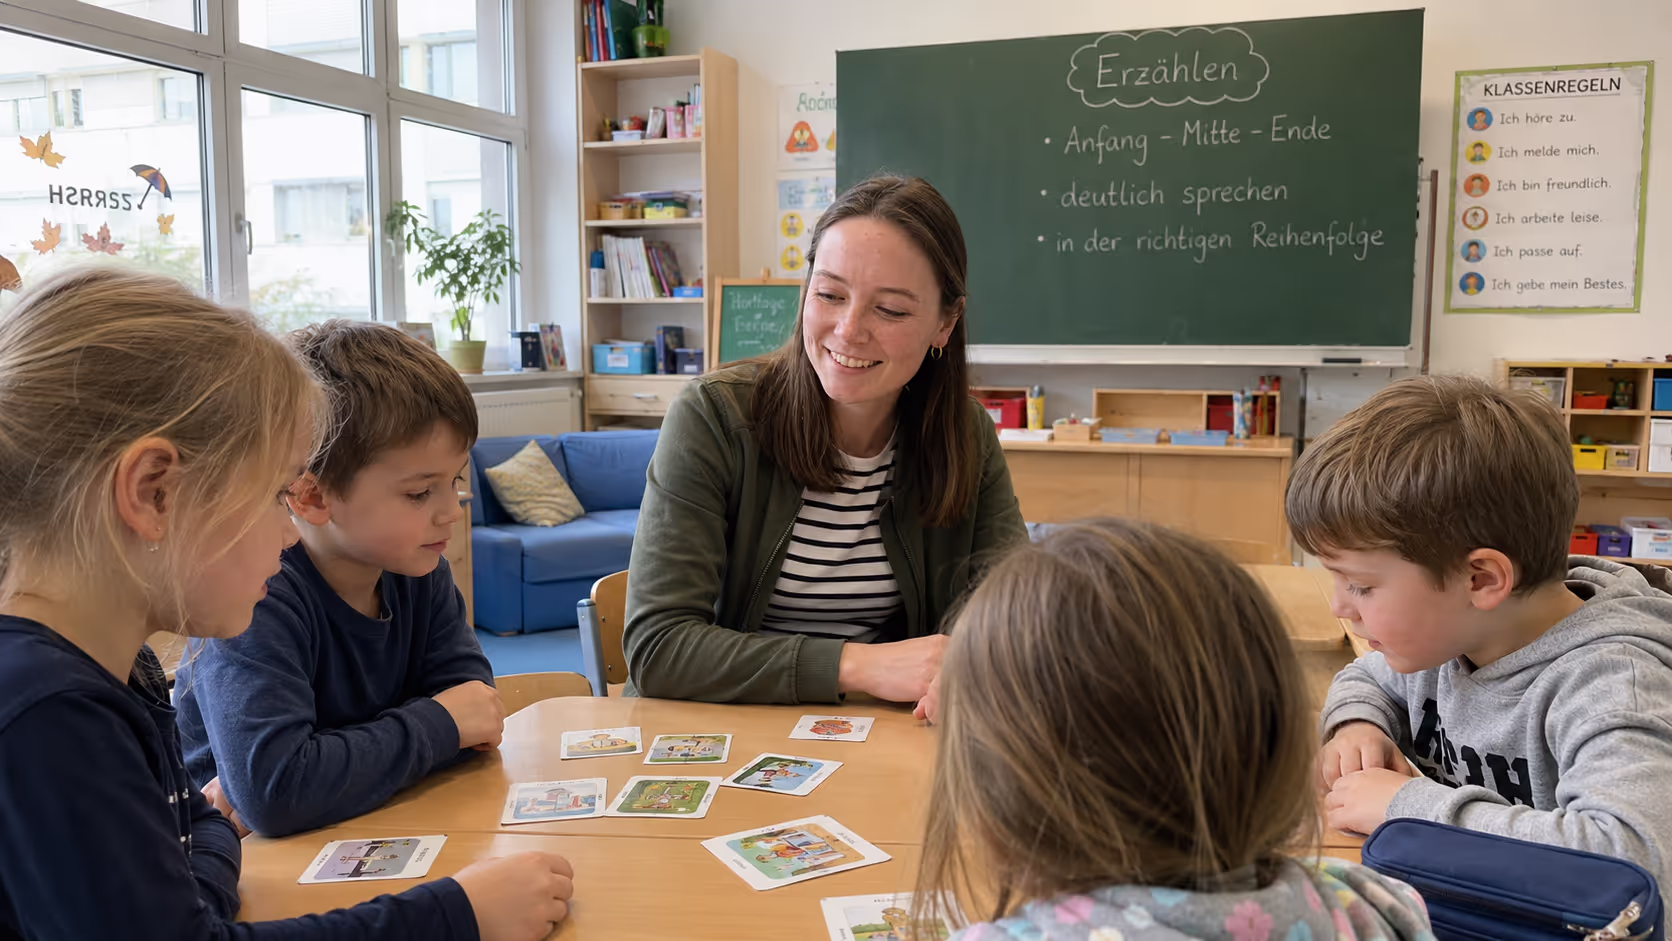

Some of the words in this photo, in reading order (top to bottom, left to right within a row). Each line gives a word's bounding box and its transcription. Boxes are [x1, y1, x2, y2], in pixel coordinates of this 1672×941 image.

[1097, 51, 1237, 88] Erzählen
[1484, 77, 1620, 96] KLASSENREGELN
[1500, 113, 1519, 124] Ich
[1526, 112, 1552, 123] höre
[1064, 125, 1147, 166] Anfang
[1183, 120, 1240, 146] Mitte
[1272, 114, 1331, 141] Ende
[1499, 147, 1518, 158] Ich
[1524, 145, 1560, 157] melde
[1567, 144, 1599, 155] mich.
[1497, 180, 1516, 191] Ich
[1523, 180, 1540, 190] bin
[1547, 177, 1612, 192] freundlich.
[1061, 180, 1164, 207] deutlich
[1183, 177, 1287, 216] sprechen
[1496, 213, 1515, 224] Ich
[1521, 213, 1564, 224] arbeite
[1571, 212, 1603, 223] leise.
[1057, 234, 1074, 253] in
[1084, 228, 1121, 252] der
[1137, 225, 1232, 264] richtigen
[1251, 221, 1384, 261] Reihenfolge
[1494, 246, 1512, 257] Ich
[1519, 248, 1553, 259] passe
[1560, 244, 1582, 257] auf.
[1491, 279, 1510, 289] Ich
[1517, 279, 1545, 294] gebe
[1550, 280, 1578, 289] mein
[1584, 278, 1627, 289] Bestes.
